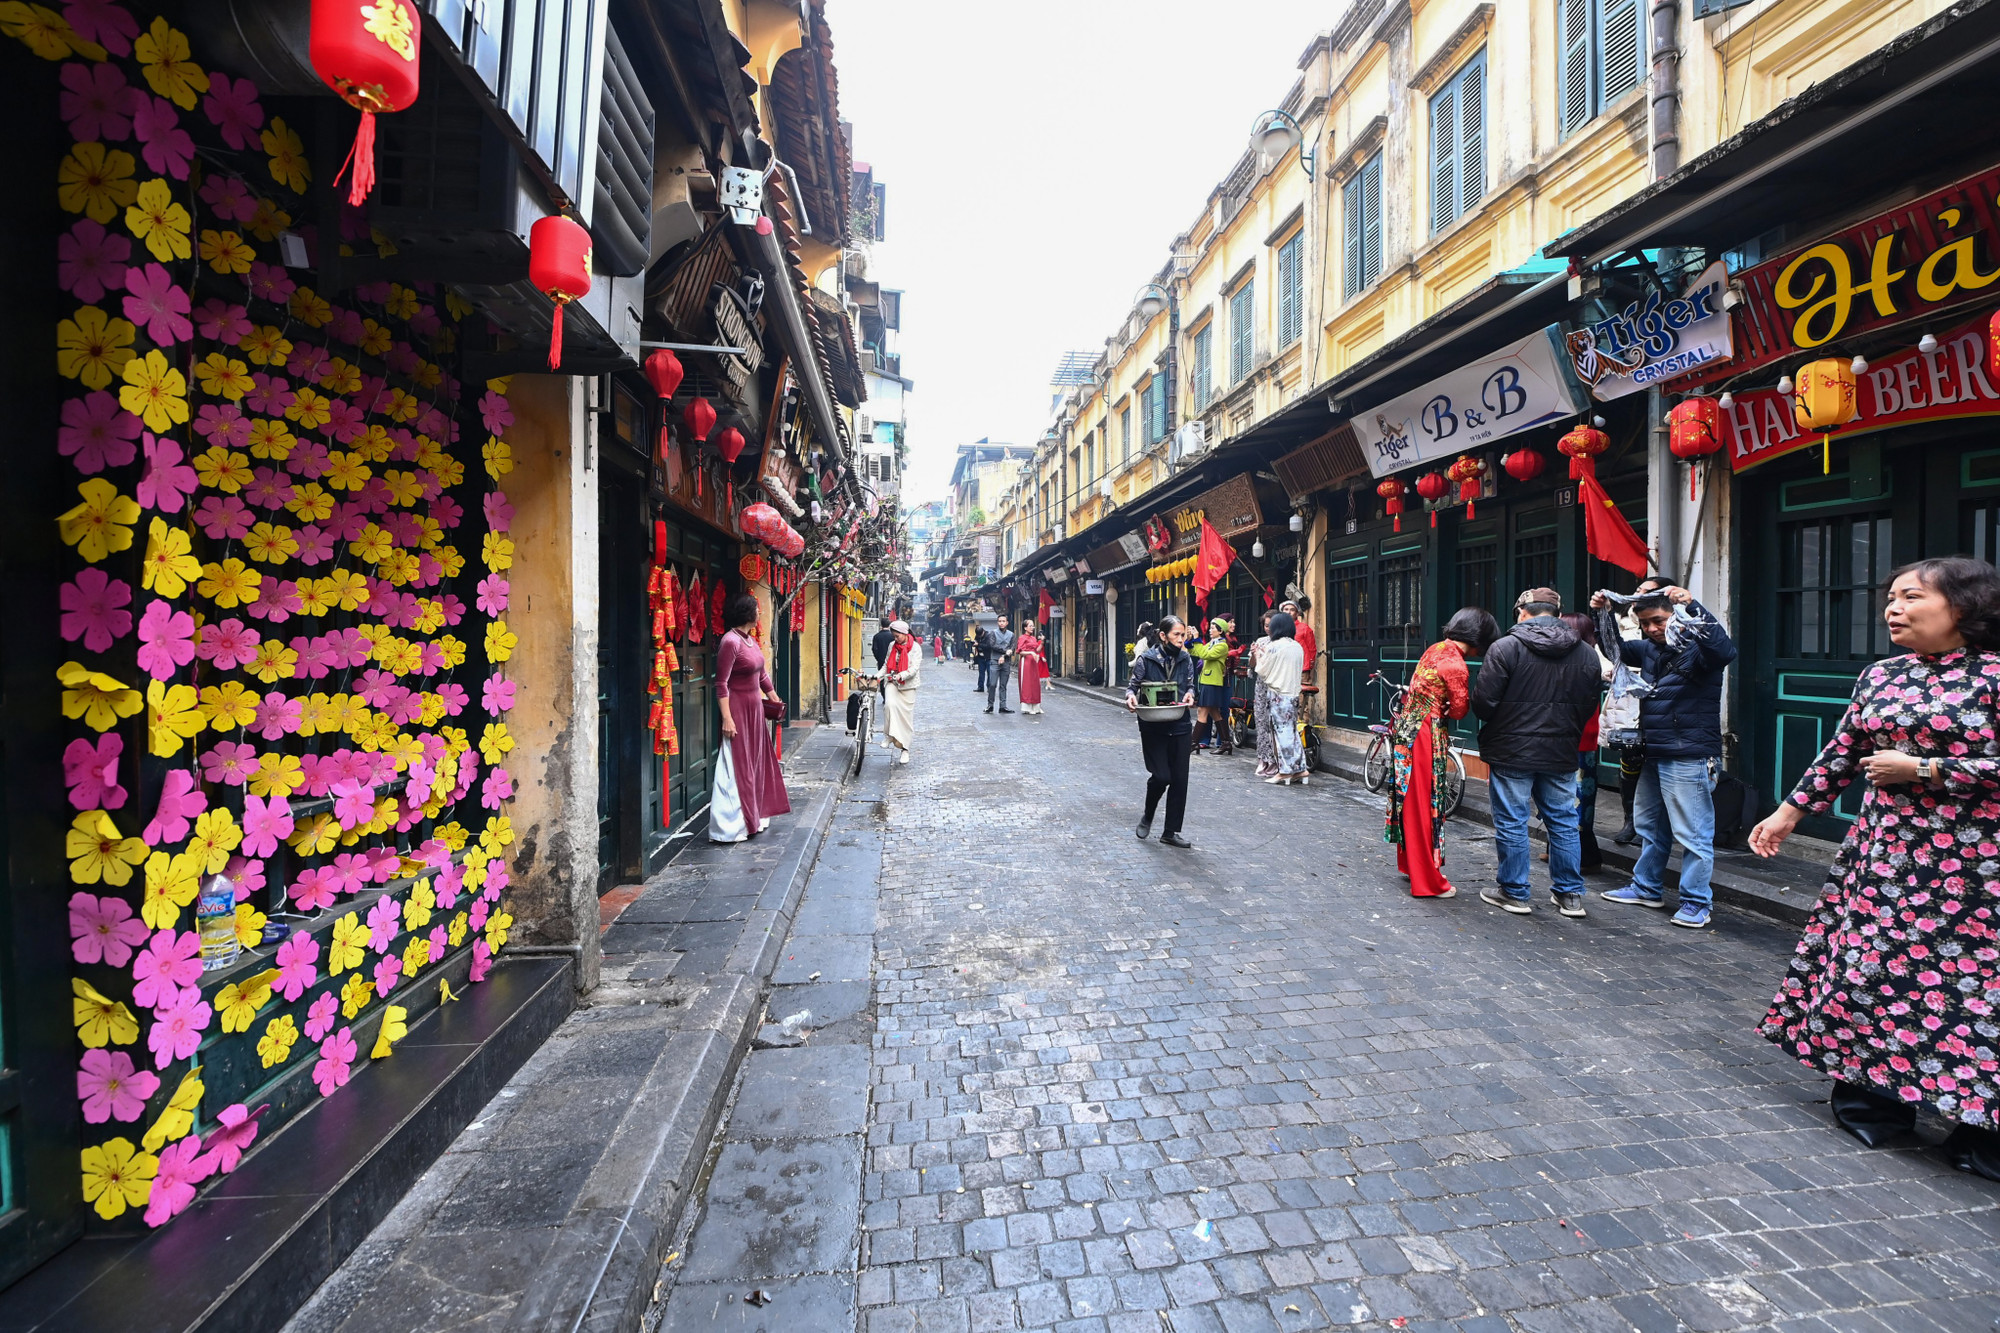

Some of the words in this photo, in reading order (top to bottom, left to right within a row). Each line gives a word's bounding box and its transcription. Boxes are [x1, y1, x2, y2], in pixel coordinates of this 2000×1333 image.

[1774, 197, 2000, 349] Hả
[714, 289, 763, 375] STRONGBOW
[1595, 284, 1713, 358] Tiger
[1632, 346, 1713, 384] CRYSTAL
[1867, 332, 2000, 418] BEER
[1421, 394, 1459, 443] B
[1463, 408, 1487, 429] &
[1481, 365, 1527, 420] B
[1374, 434, 1410, 460] Tiger
[1388, 458, 1413, 471] CRYSTAL
[1558, 490, 1571, 505] 19
[1173, 507, 1205, 534] Olive
[1347, 521, 1355, 532] 19
[197, 903, 225, 914] aVie
